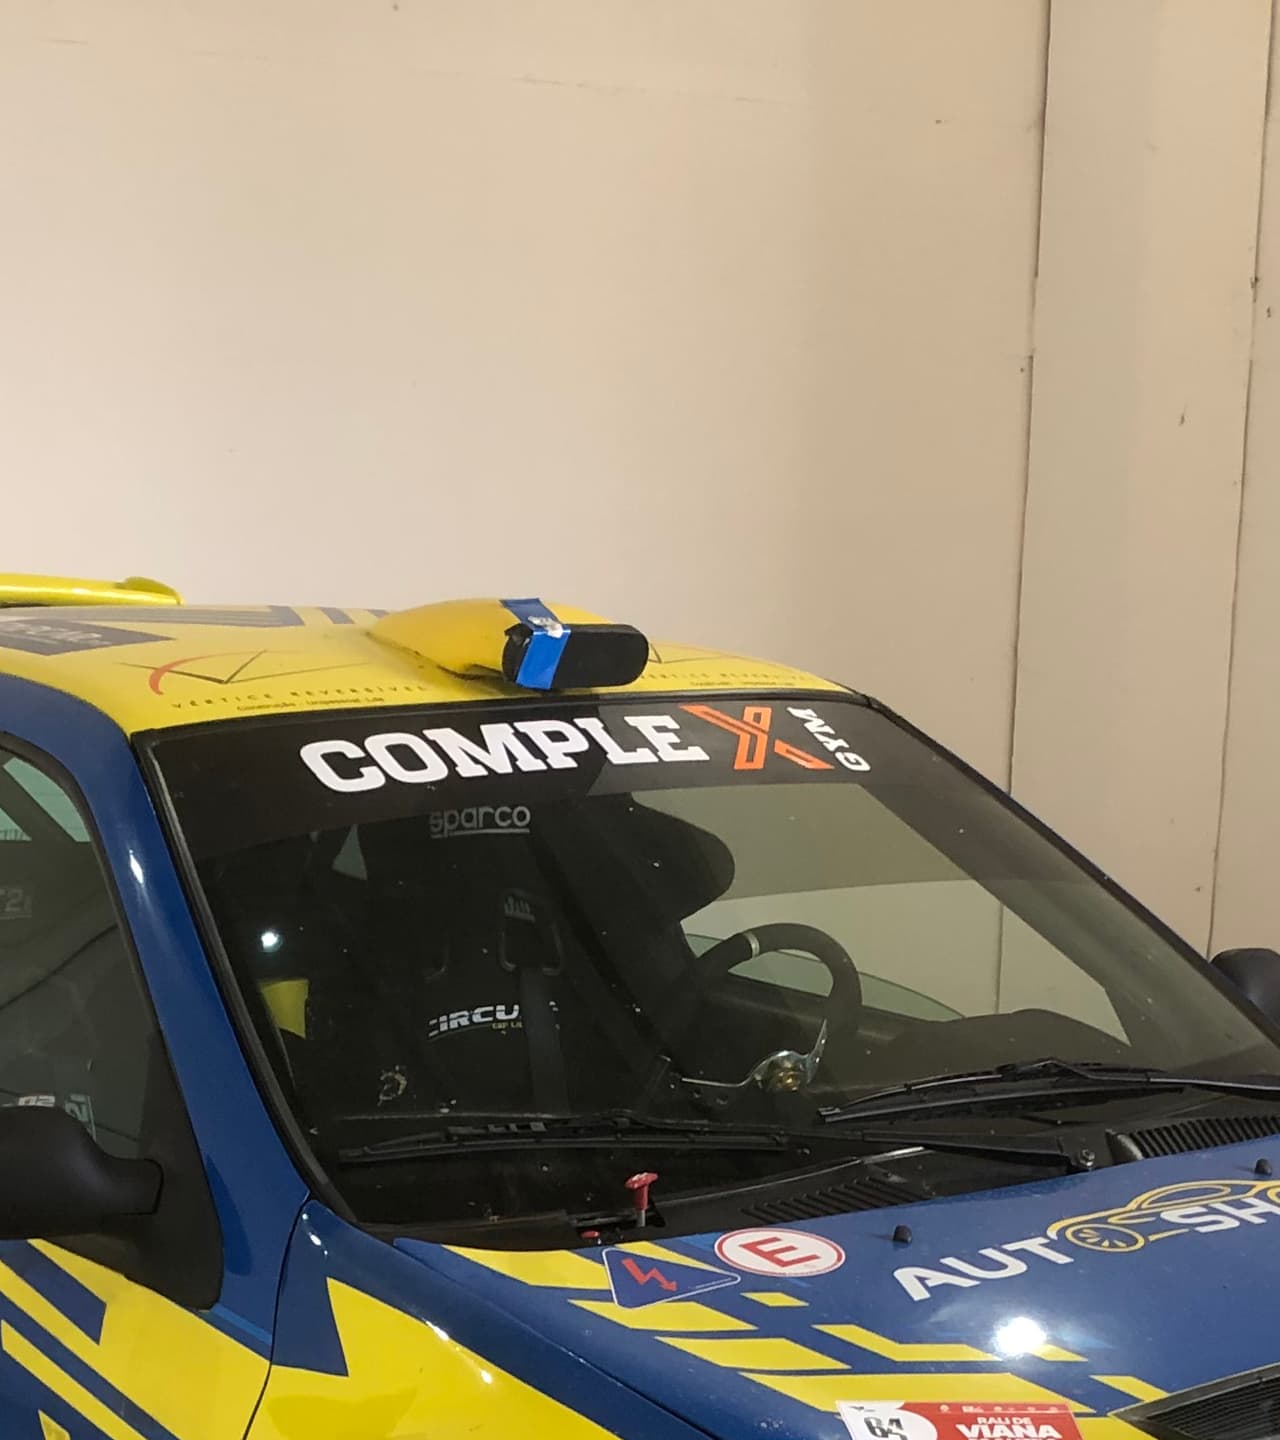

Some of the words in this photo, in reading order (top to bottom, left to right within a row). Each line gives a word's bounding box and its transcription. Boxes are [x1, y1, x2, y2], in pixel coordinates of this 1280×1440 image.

[299, 703, 835, 795] COMPLEX
[786, 706, 871, 771] GYM
[429, 804, 531, 833] sparco
[737, 1236, 822, 1269] E
[955, 1423, 1064, 1440] VIANA
[976, 1415, 1010, 1426] RALI
[1014, 1416, 1034, 1426] DE
